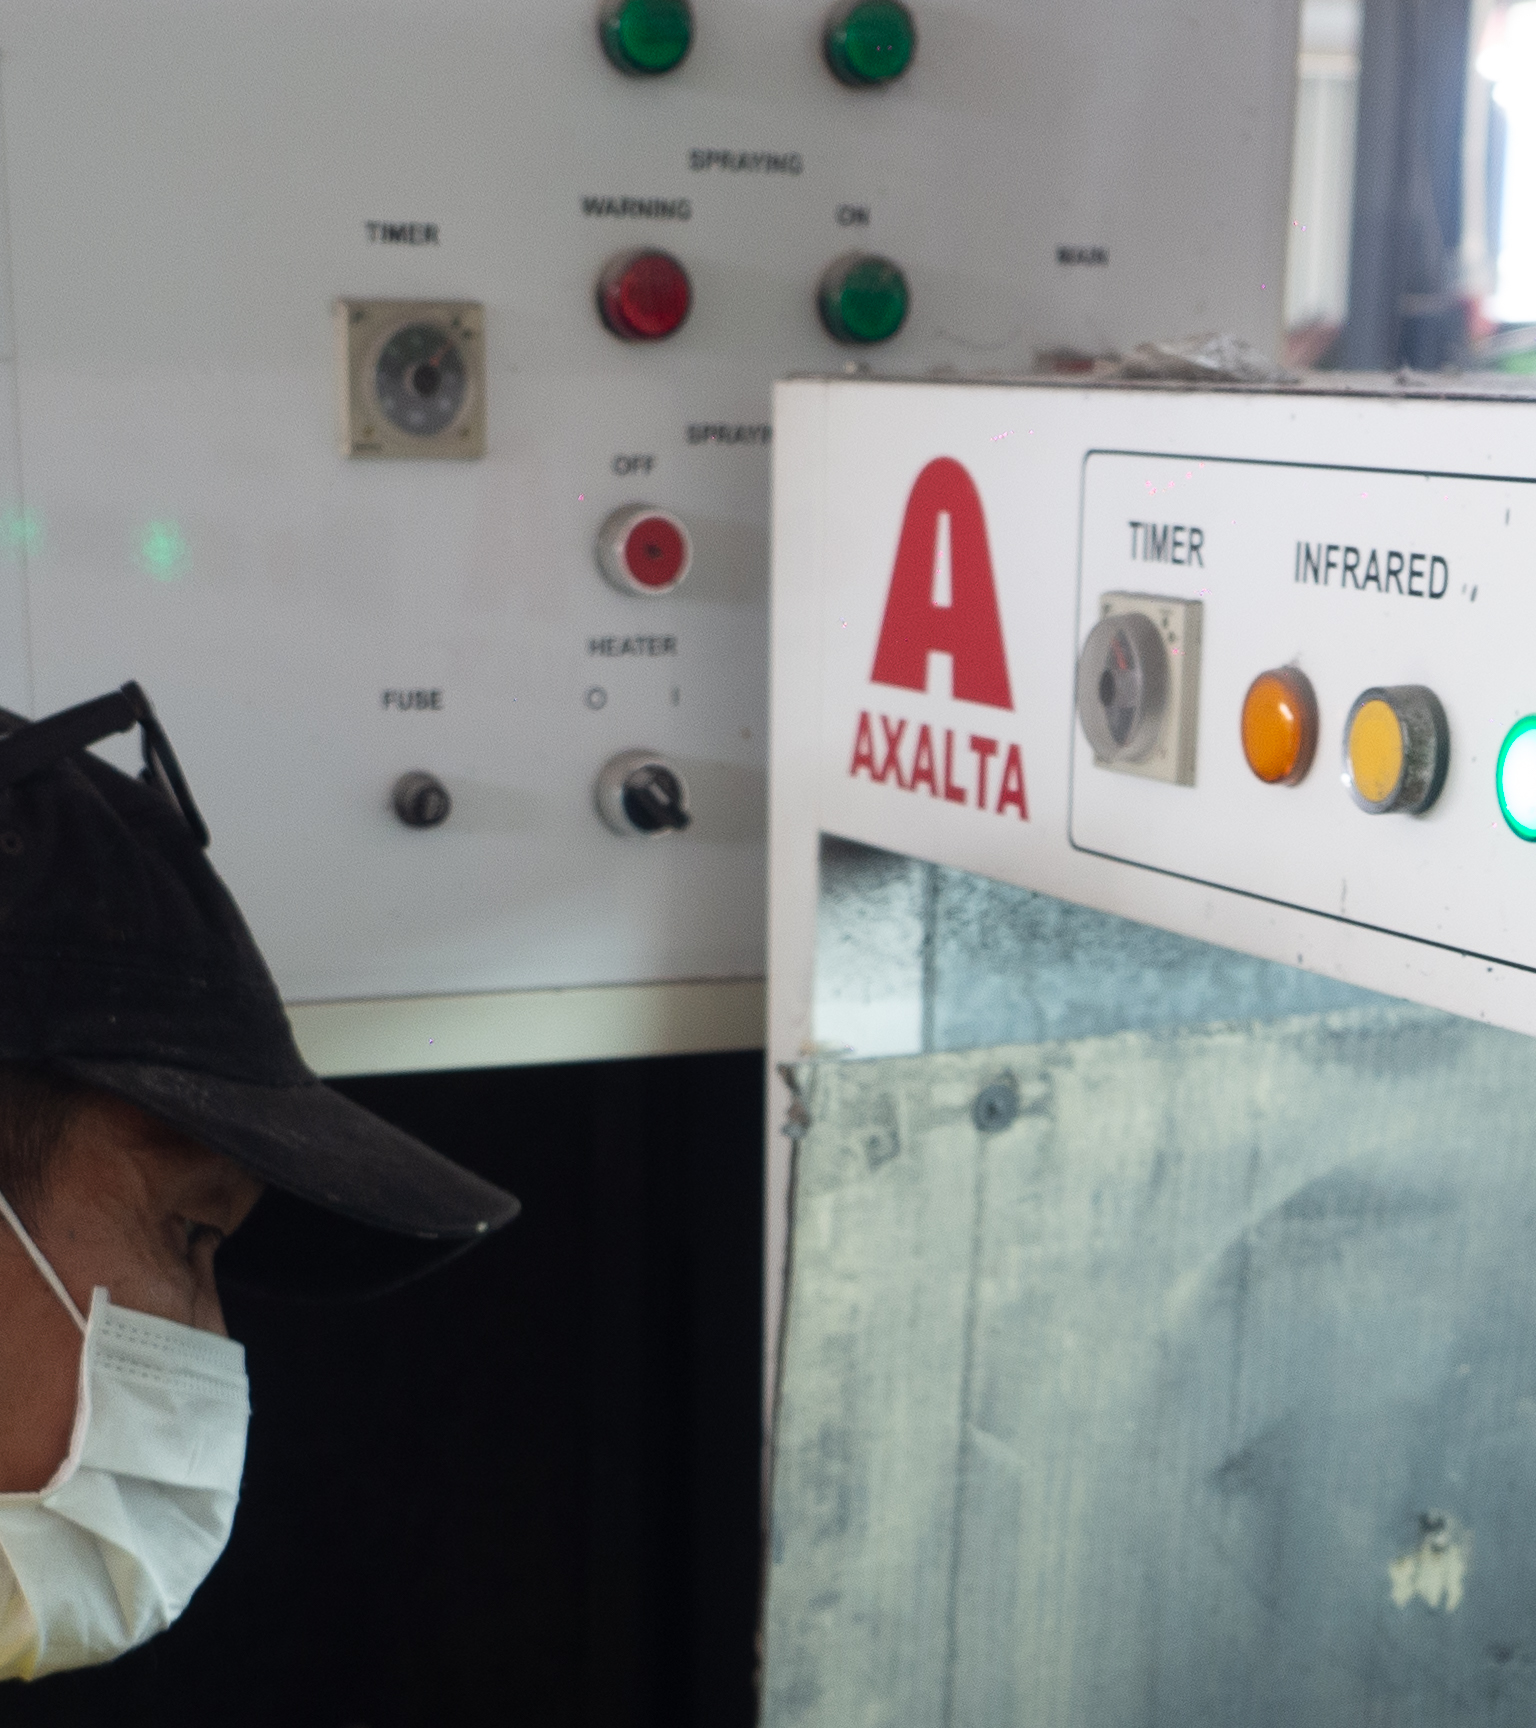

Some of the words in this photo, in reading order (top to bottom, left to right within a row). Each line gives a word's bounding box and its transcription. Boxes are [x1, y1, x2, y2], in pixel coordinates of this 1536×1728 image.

[687, 148, 803, 176] SPRAYING
[581, 196, 691, 221] WARNING
[835, 204, 870, 228] ON
[365, 221, 439, 246] TIMER
[611, 454, 656, 477] OFF
[1128, 520, 1205, 567] TIMER
[1295, 542, 1449, 600] INFRARED
[587, 634, 677, 657] HEATER
[381, 689, 442, 711] FUSE
[850, 710, 1030, 821] AXALTA
